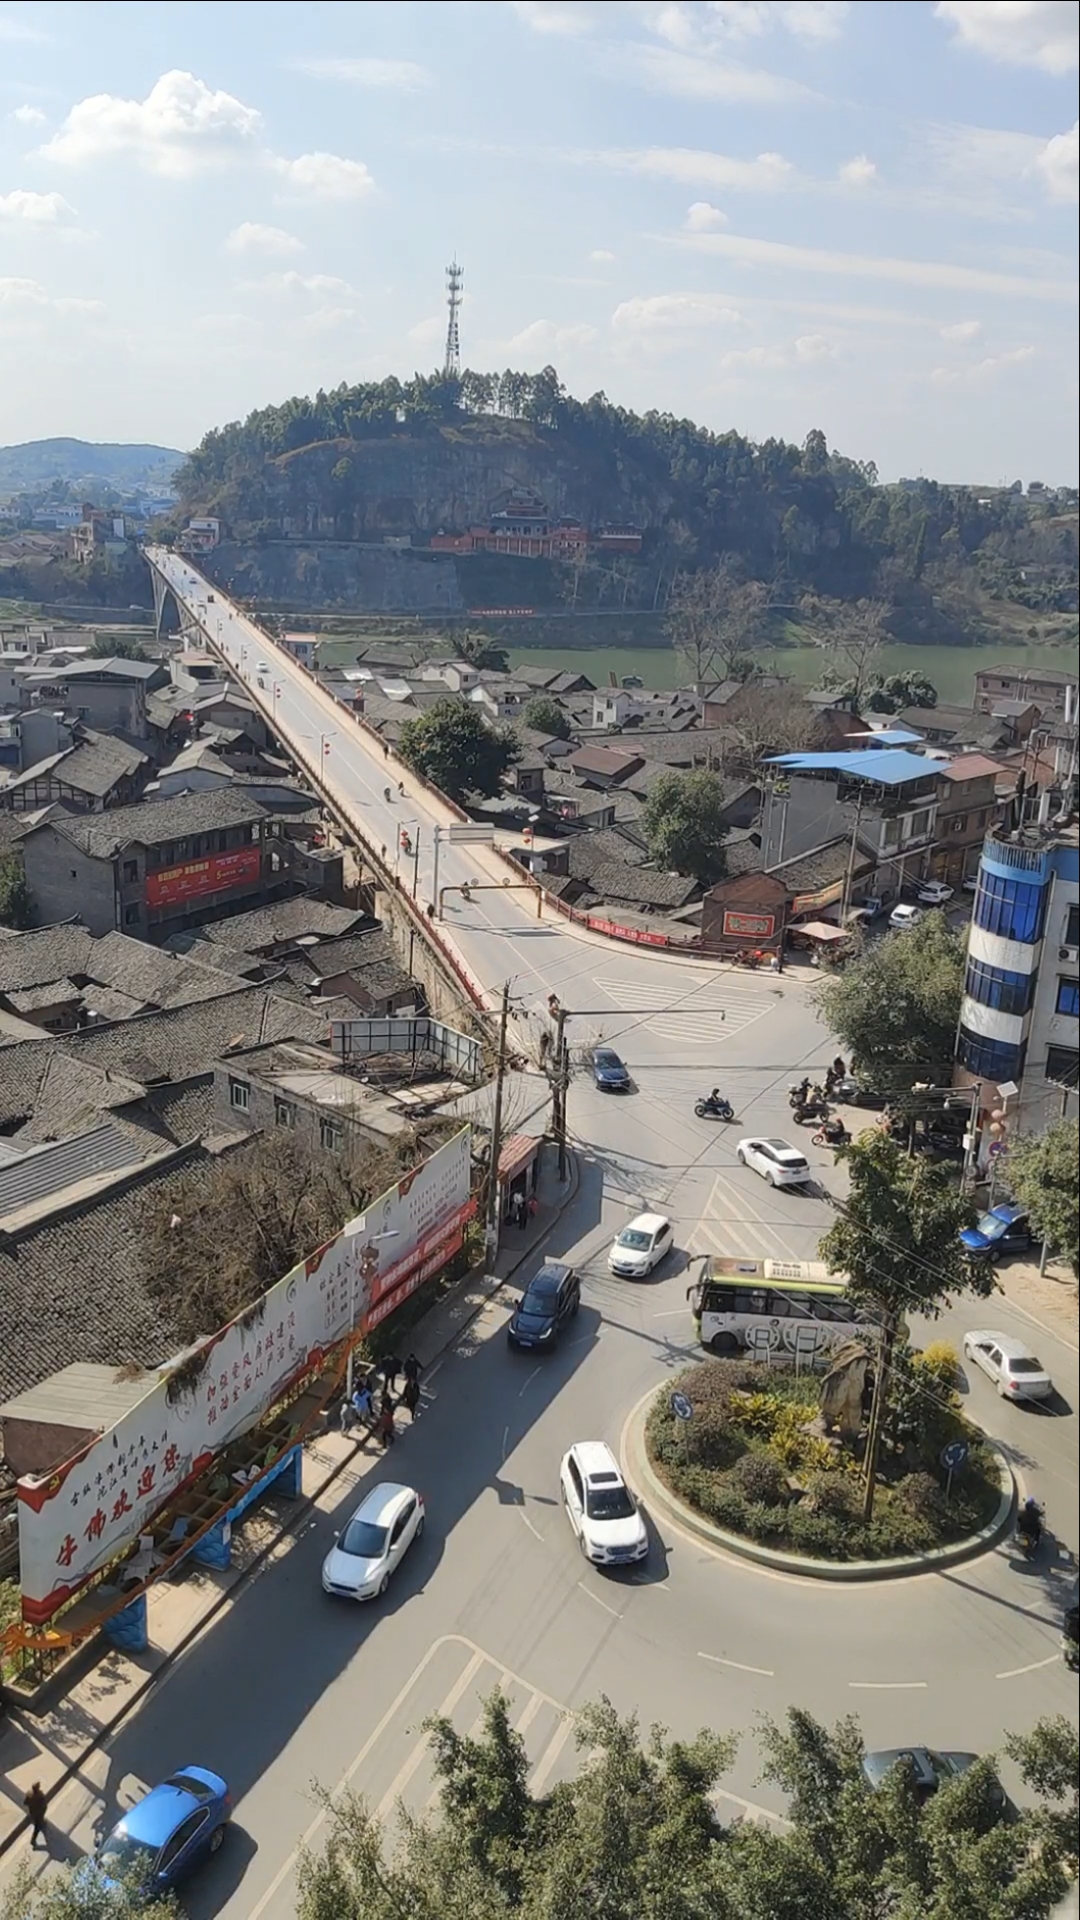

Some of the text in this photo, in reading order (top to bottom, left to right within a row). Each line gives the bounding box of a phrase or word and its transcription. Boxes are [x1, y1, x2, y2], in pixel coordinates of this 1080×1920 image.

[55, 1442, 181, 1567] 牛佛欢迎您
